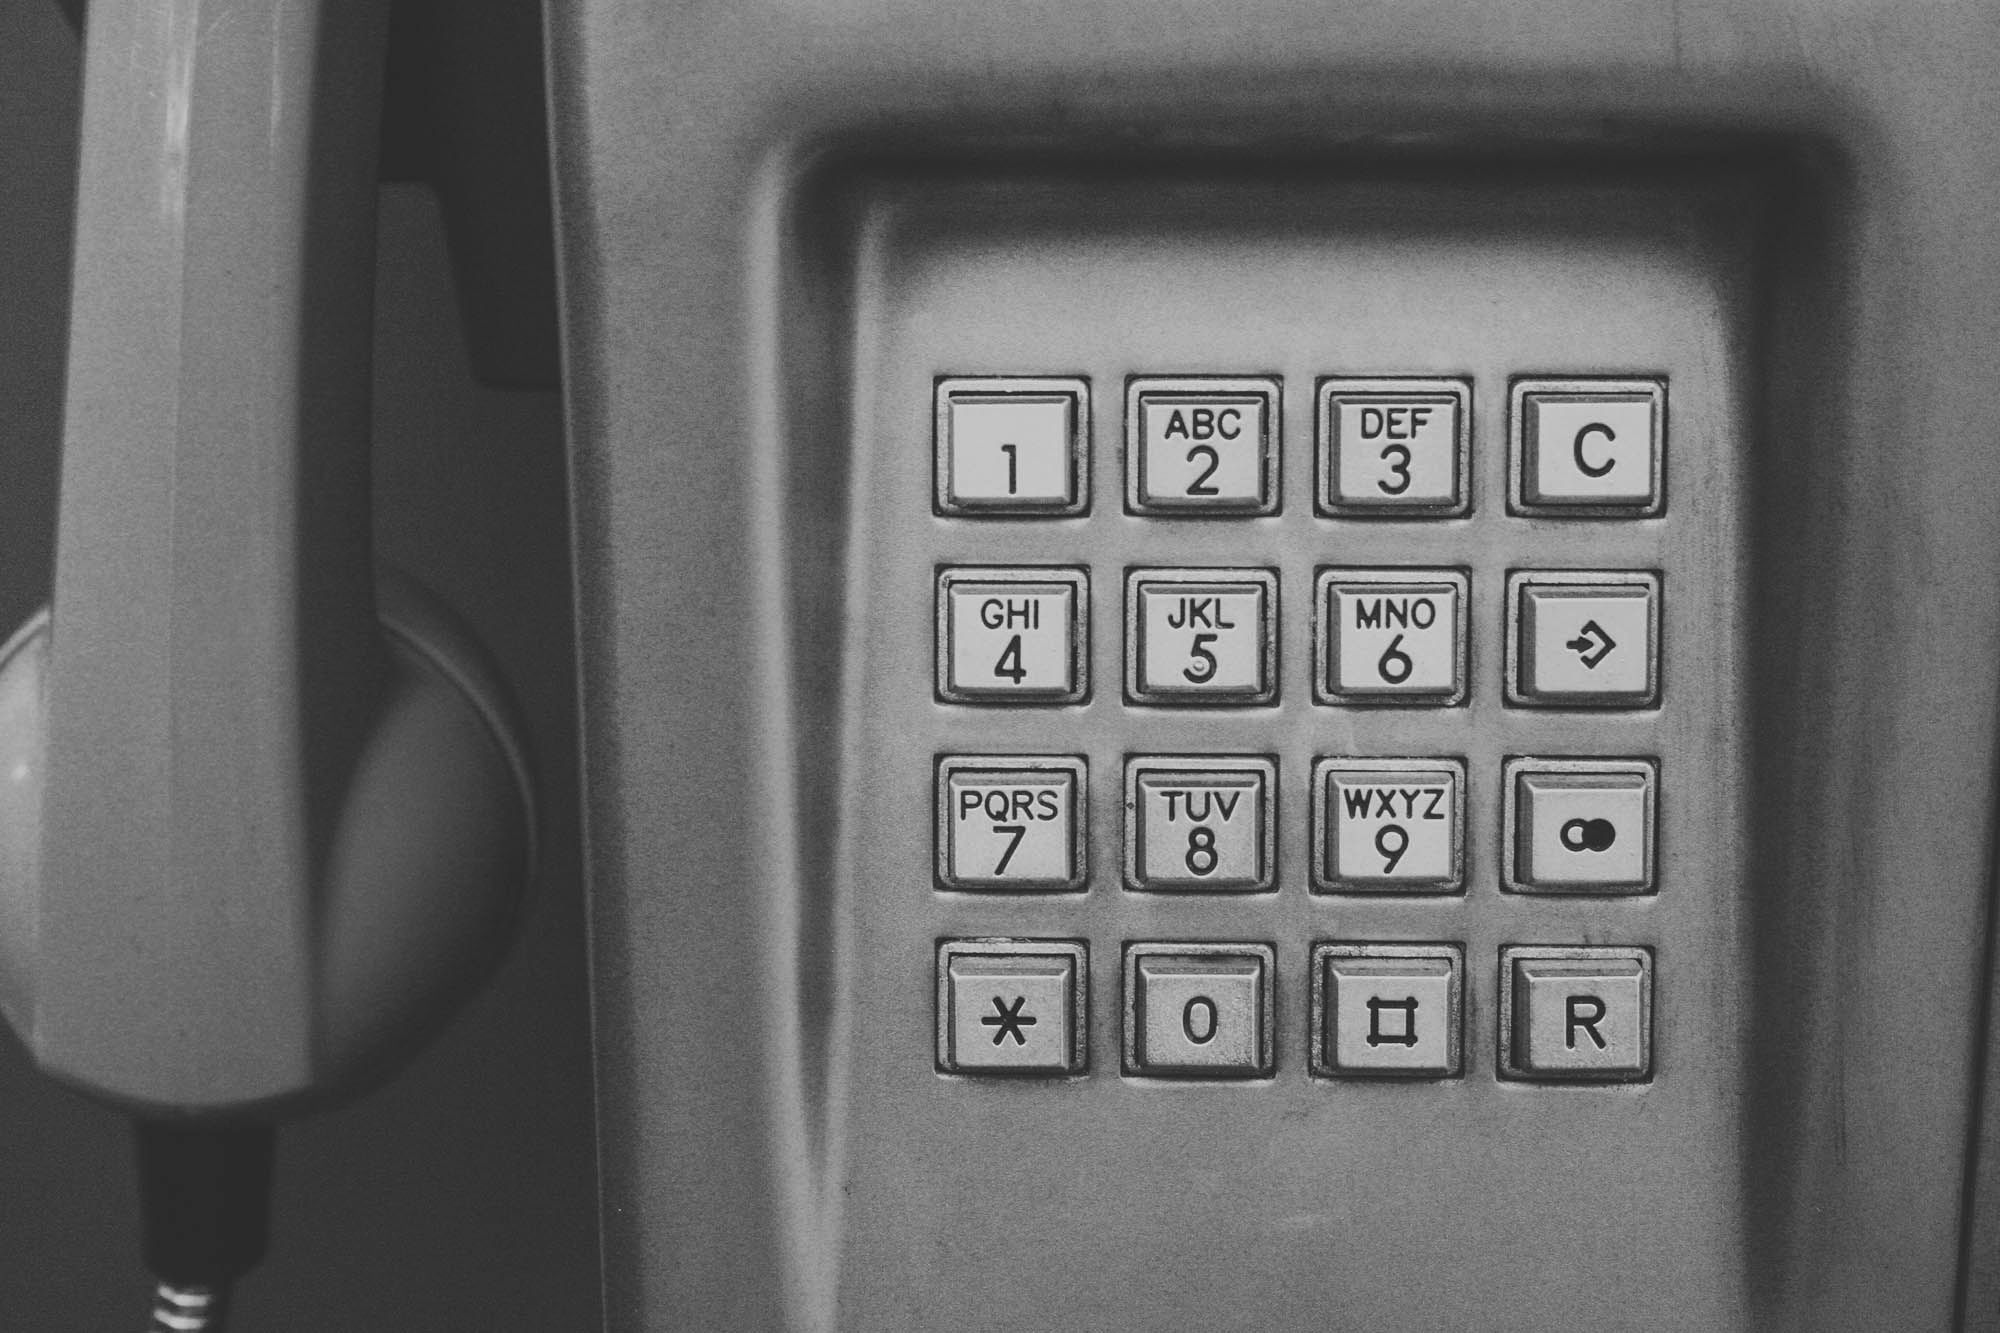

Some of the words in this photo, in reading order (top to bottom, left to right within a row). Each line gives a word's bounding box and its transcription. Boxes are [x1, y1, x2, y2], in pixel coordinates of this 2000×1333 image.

[1164, 408, 1241, 441] ABC
[1360, 407, 1433, 440] DEF
[1001, 444, 1017, 495] 1
[1186, 444, 1220, 496] 2
[1377, 443, 1412, 496] 3
[1573, 422, 1616, 478] C
[980, 598, 1039, 630] GHI
[1167, 597, 1235, 629] JKL
[1356, 598, 1436, 630] MNO
[994, 634, 1027, 685] 4
[1182, 634, 1218, 684] 5
[1378, 633, 1413, 685] 6
[960, 789, 1059, 823] PQRS
[1159, 790, 1241, 823] TUV
[1343, 788, 1445, 820] WXYZ
[992, 825, 1027, 876] 7
[1185, 826, 1219, 877] 8
[1374, 823, 1410, 875] 9
[1182, 994, 1220, 1045] 0
[1565, 994, 1607, 1050] R
